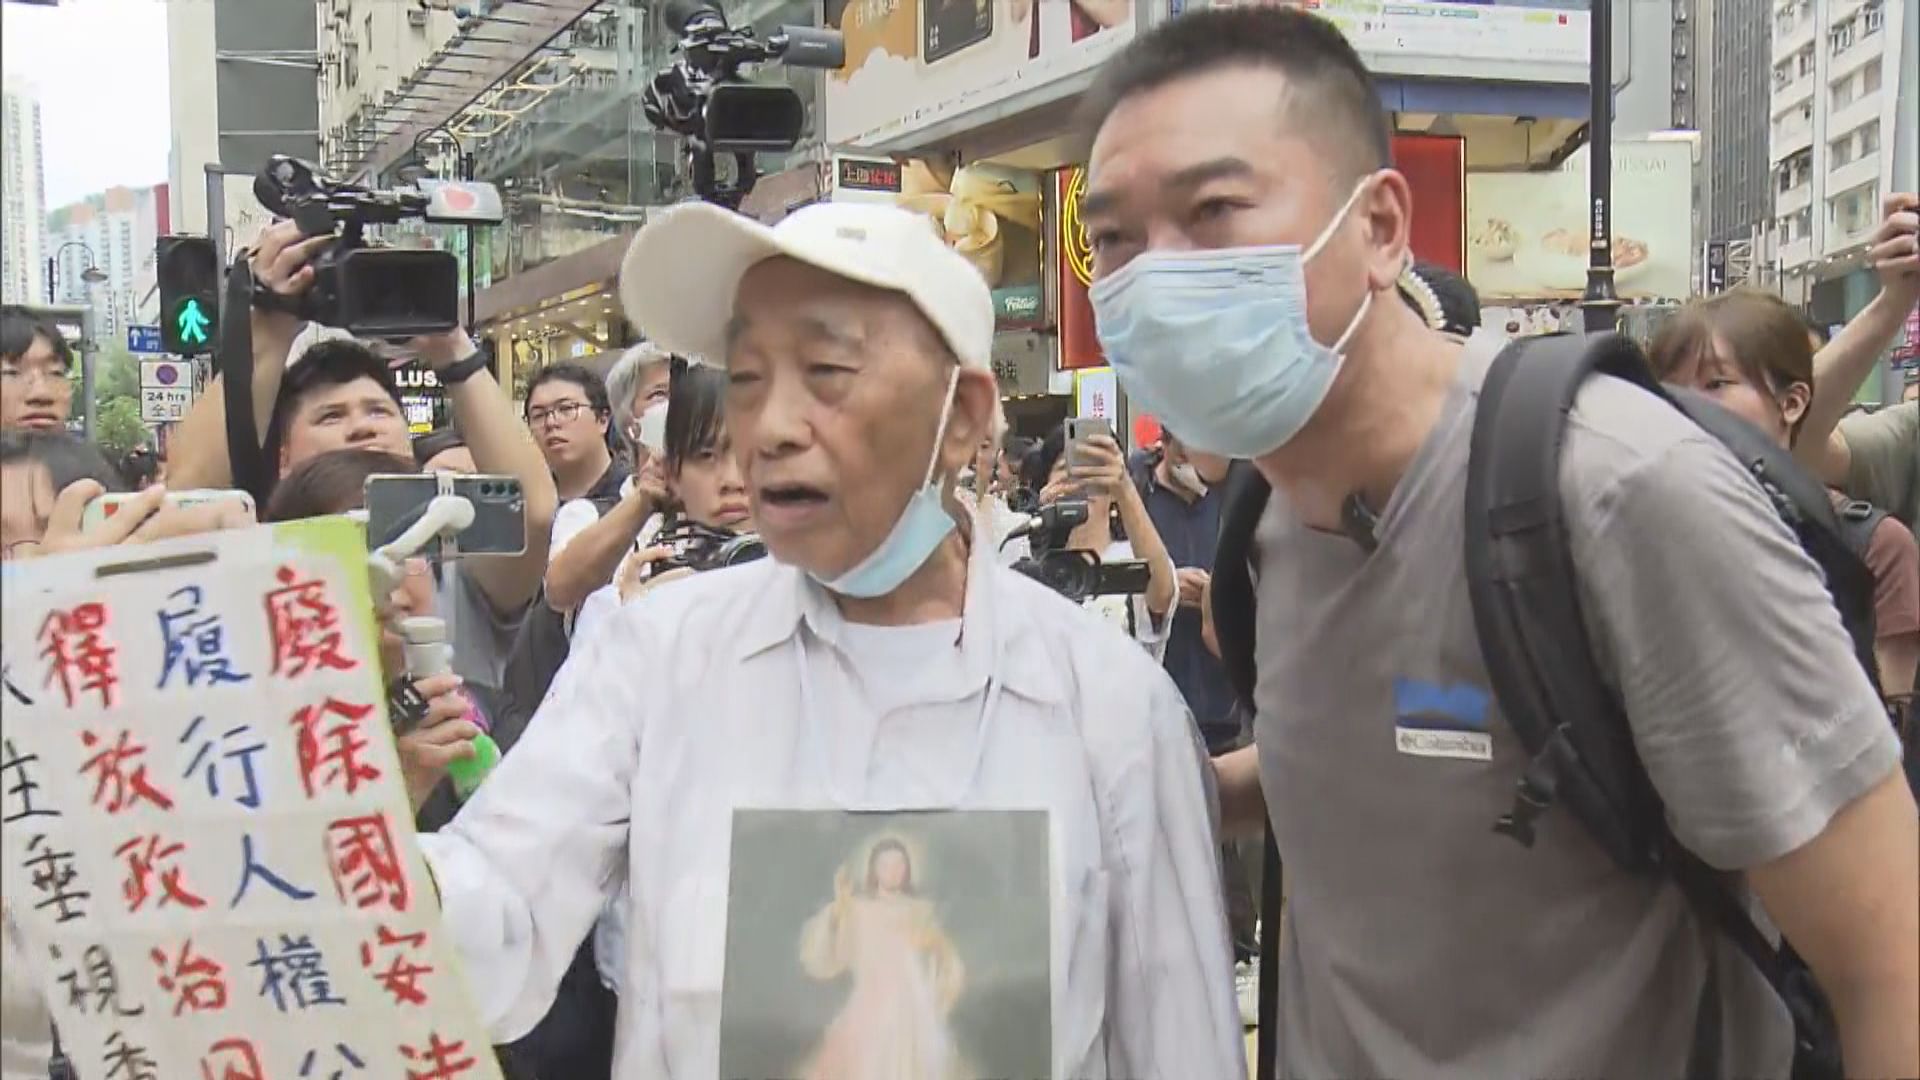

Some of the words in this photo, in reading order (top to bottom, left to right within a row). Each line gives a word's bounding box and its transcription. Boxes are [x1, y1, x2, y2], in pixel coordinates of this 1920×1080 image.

[395, 369, 444, 388] LUS
[147, 392, 164, 401] 24
[167, 392, 186, 401] hrs
